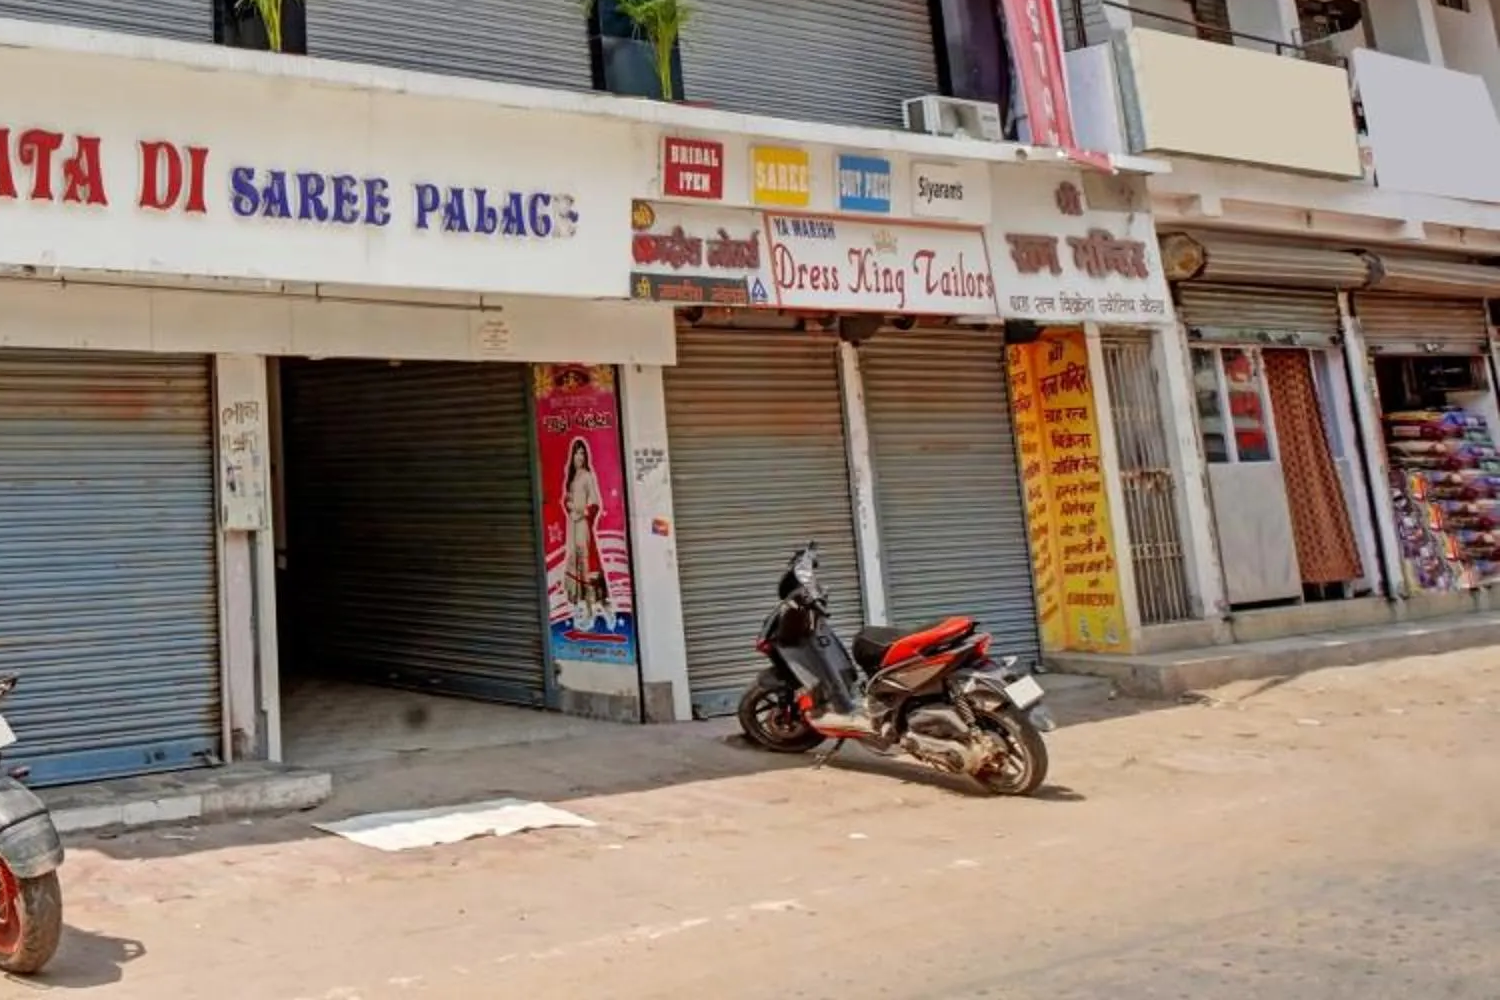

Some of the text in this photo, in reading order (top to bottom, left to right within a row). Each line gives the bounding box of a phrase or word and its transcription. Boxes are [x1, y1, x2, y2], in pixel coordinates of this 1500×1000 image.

[671, 145, 718, 167] BRIDAL
[139, 140, 209, 214] DI
[231, 167, 392, 227] SAREE
[679, 172, 711, 193] ITEM
[756, 162, 809, 193] SAREE
[773, 219, 795, 236] YA
[773, 243, 839, 291] Dress
[848, 247, 905, 309] King
[913, 249, 996, 298] Tailors
